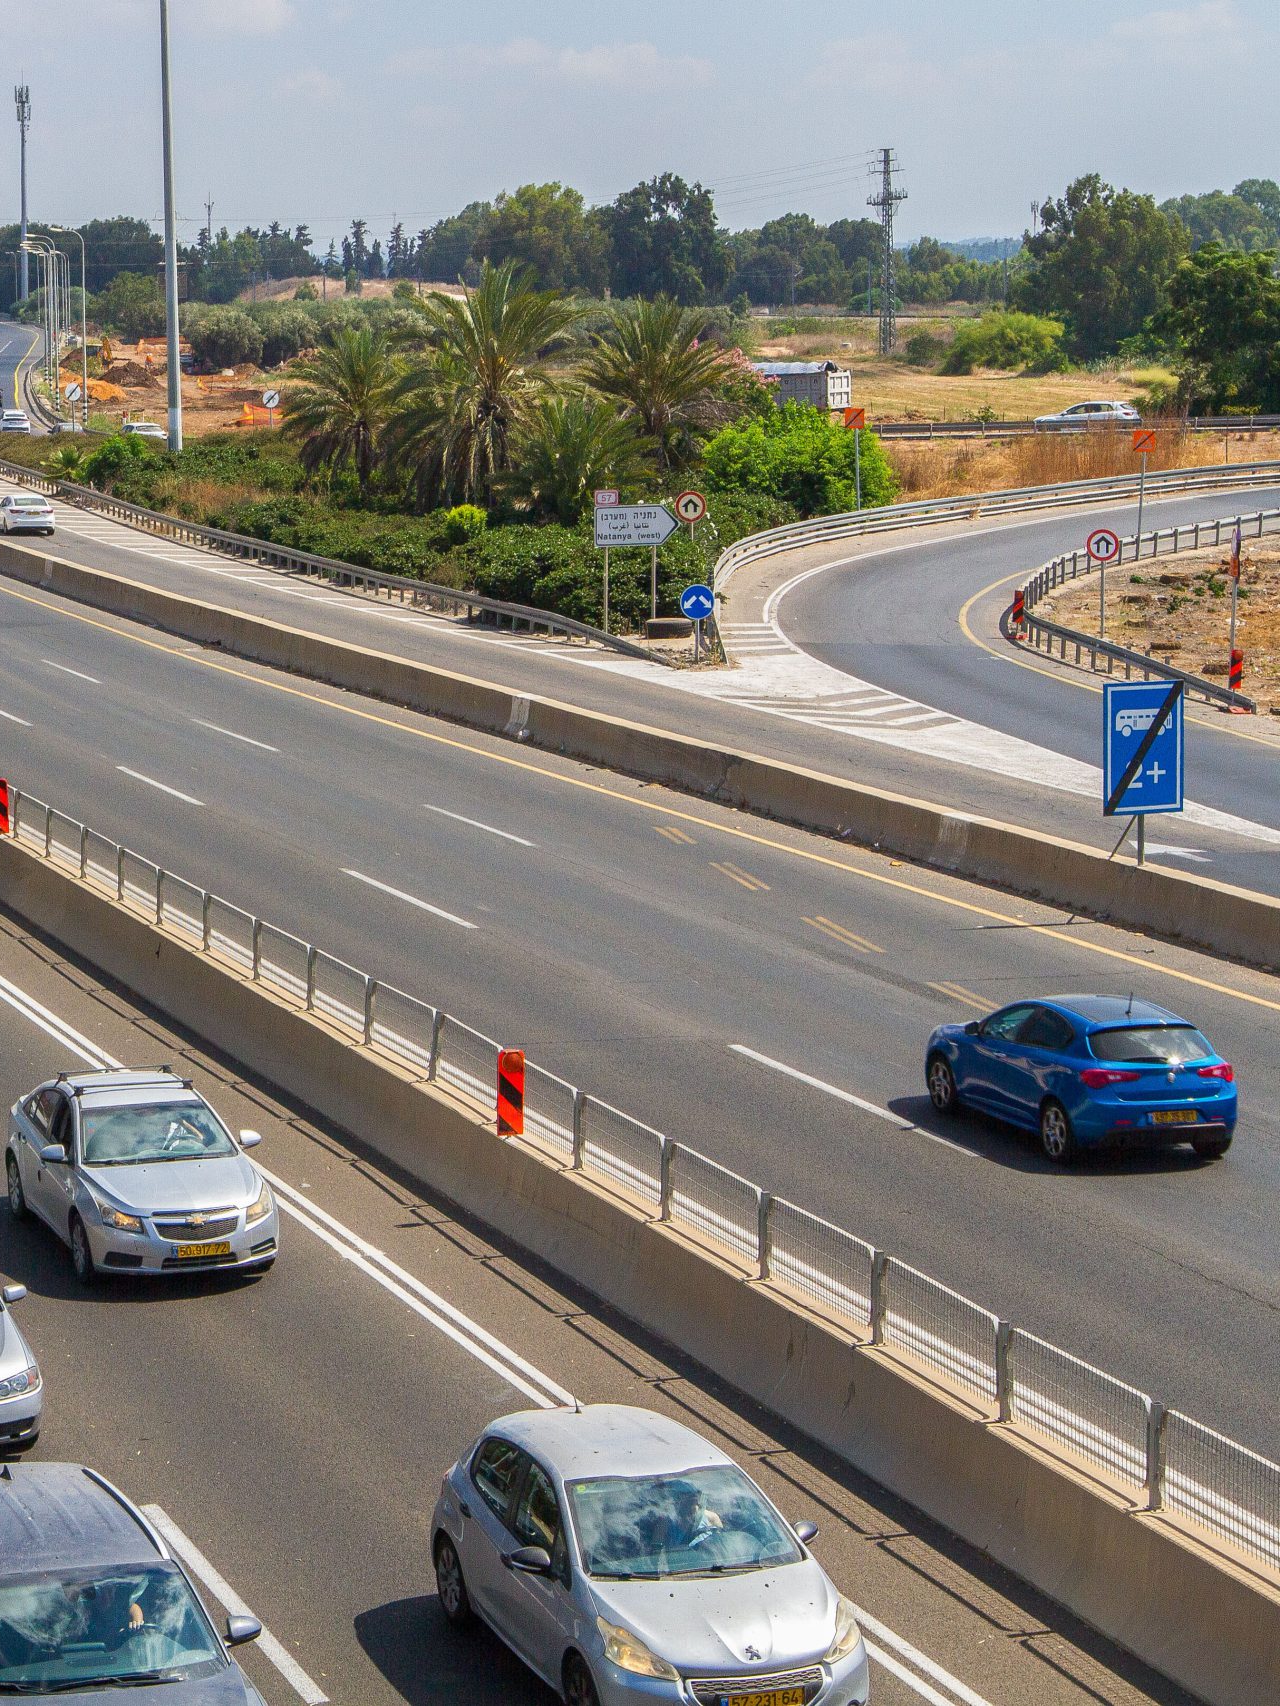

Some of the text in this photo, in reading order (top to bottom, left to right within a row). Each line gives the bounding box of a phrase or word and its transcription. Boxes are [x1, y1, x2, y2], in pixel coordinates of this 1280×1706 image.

[602, 494, 612, 502] 57
[600, 511, 657, 521] נתניה (מערב)
[597, 531, 661, 542] Natanya (west)
